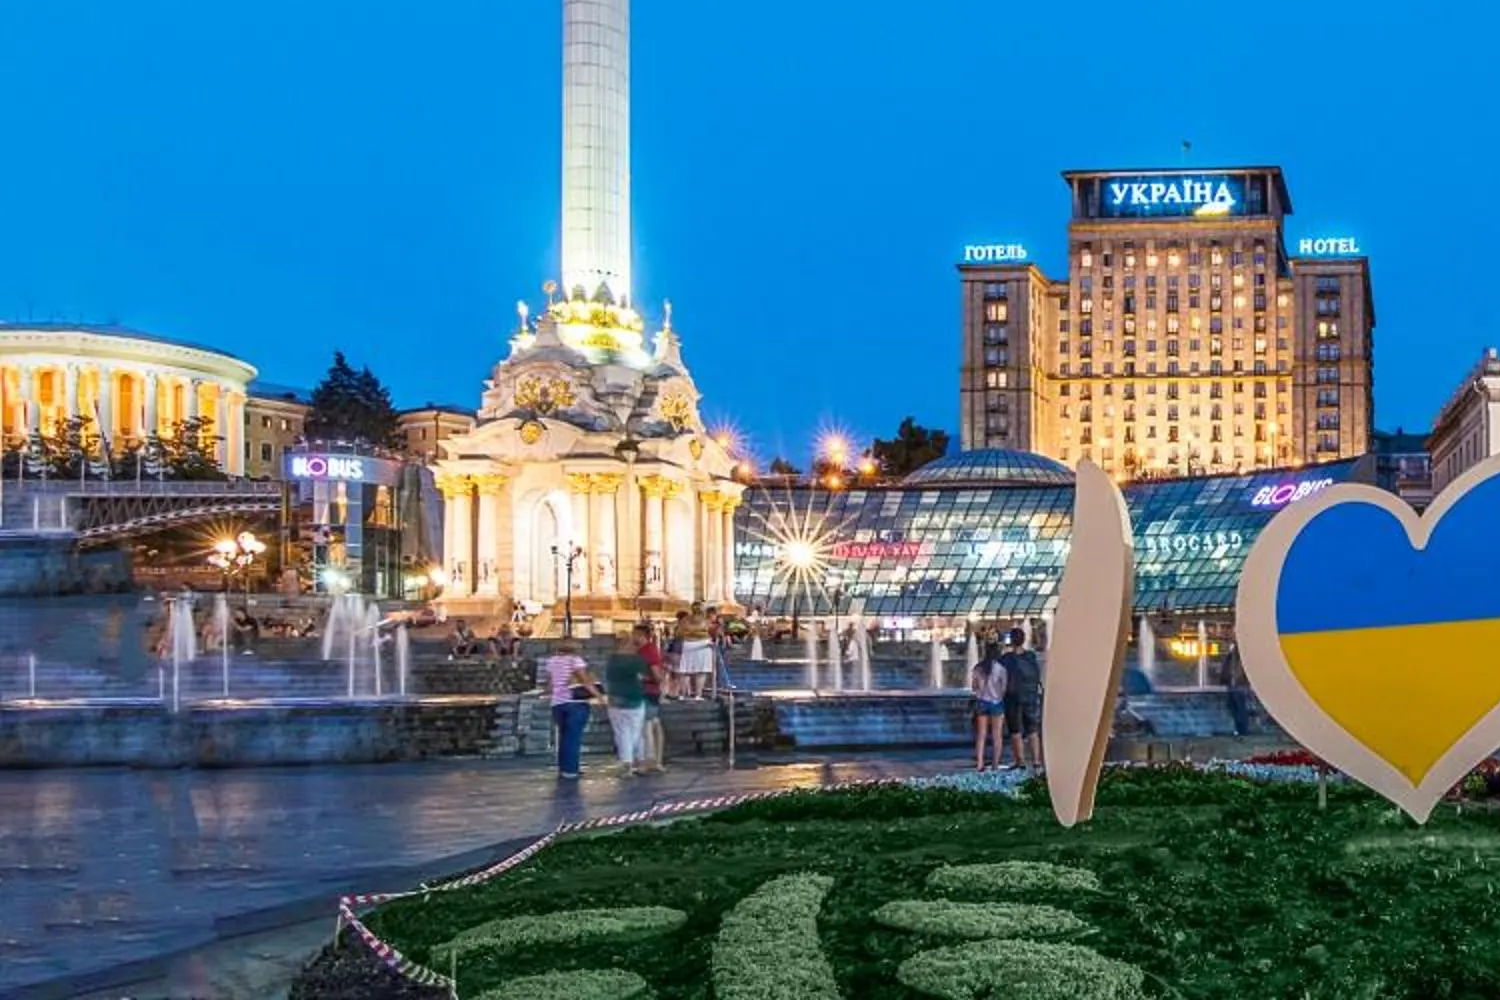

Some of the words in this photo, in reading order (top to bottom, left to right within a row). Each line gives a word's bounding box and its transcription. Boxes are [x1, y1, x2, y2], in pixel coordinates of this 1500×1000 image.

[1111, 179, 1236, 205] УКРАЇНА
[964, 243, 1028, 261] ГОТЕЛЬ
[1299, 237, 1360, 255] HOTEL
[1042, 456, 1135, 828] I
